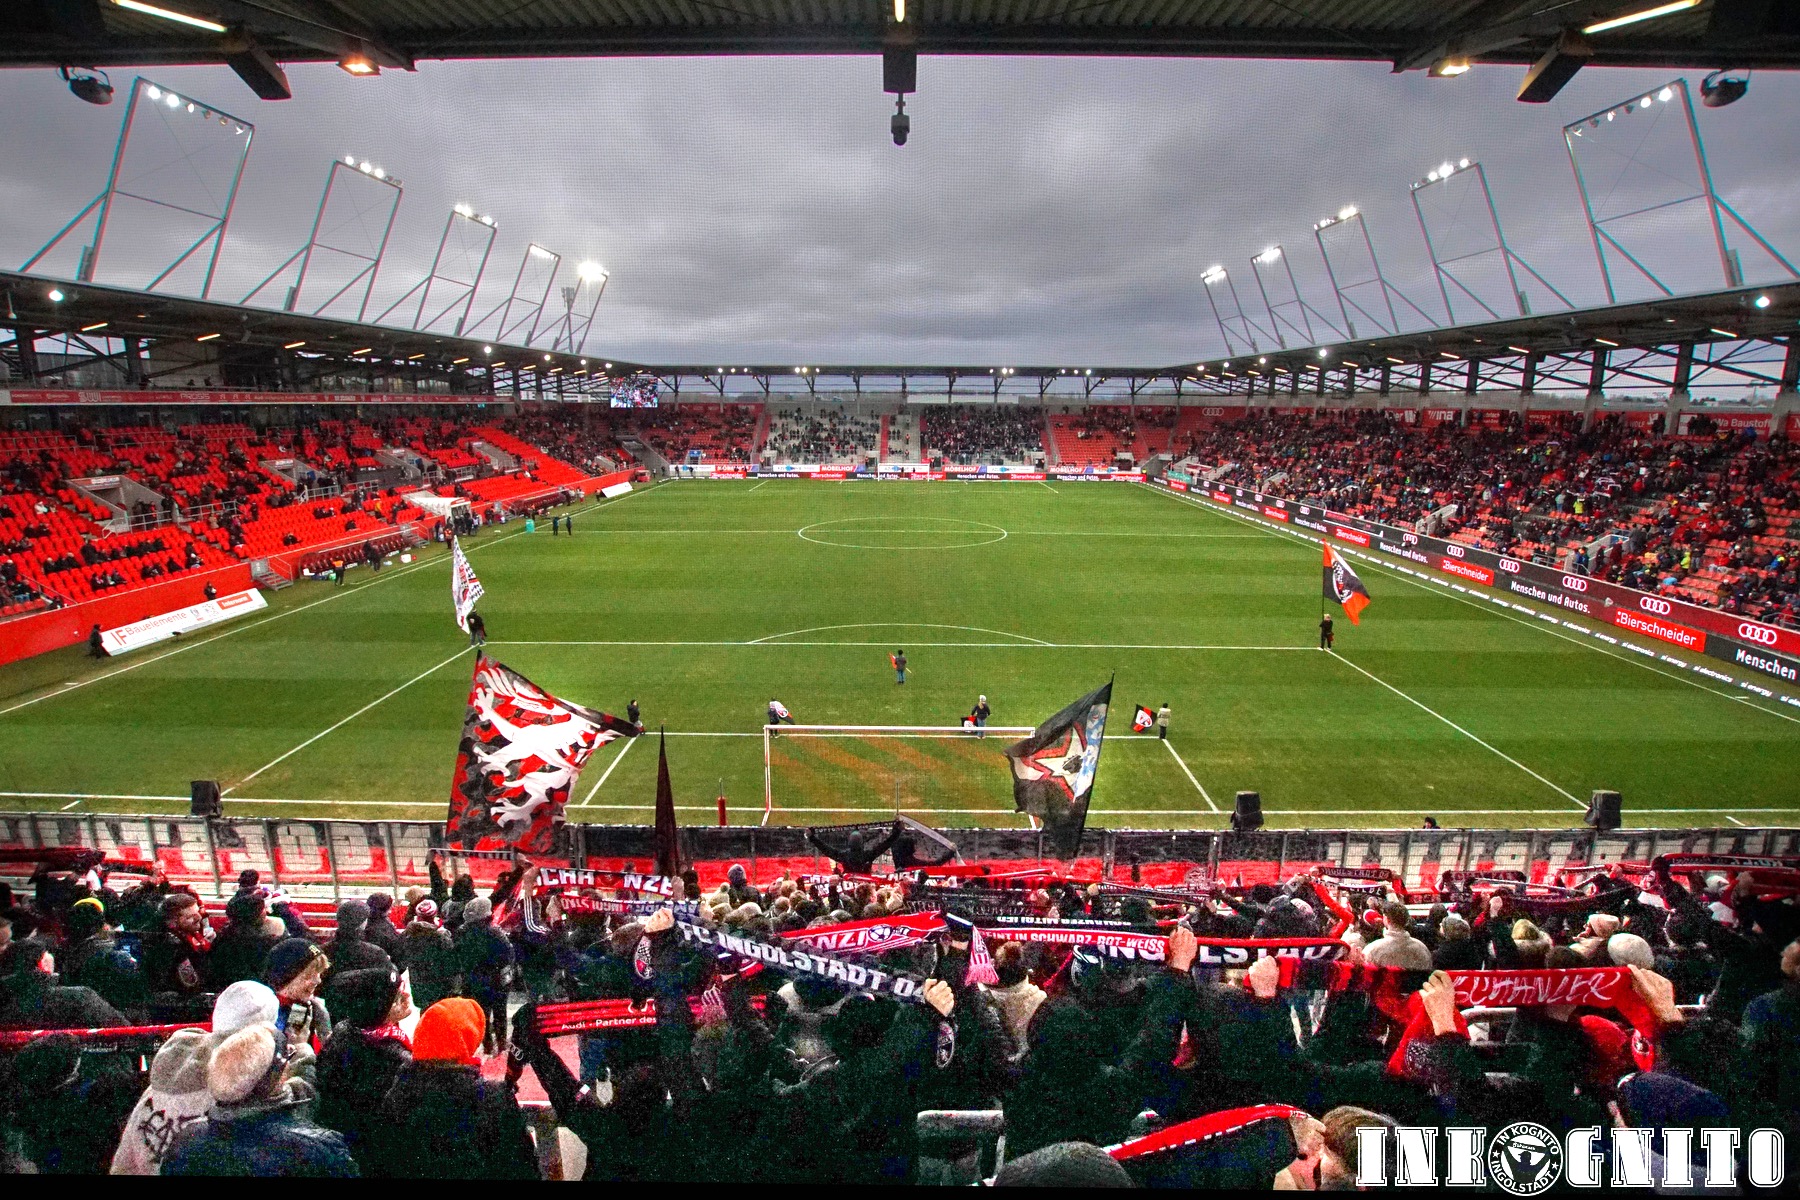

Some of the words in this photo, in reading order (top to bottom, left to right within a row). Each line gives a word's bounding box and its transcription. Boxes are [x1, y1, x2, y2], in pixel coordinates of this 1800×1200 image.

[1380, 541, 1402, 555] Menschen
[1402, 547, 1411, 559] und
[1413, 550, 1428, 563] Autos.
[1511, 580, 1546, 600] Menschen
[1548, 591, 1562, 604] und
[1564, 596, 1590, 614] Autos.
[125, 611, 188, 636] Bauelemente
[1699, 667, 1733, 683] electronics
[1735, 648, 1797, 680] Menschen
[1748, 684, 1772, 697] energy
[717, 932, 887, 991] INGOLSTADT
[561, 1022, 587, 1034] Audi
[596, 1015, 635, 1029] Partner
[639, 1014, 657, 1025] des
